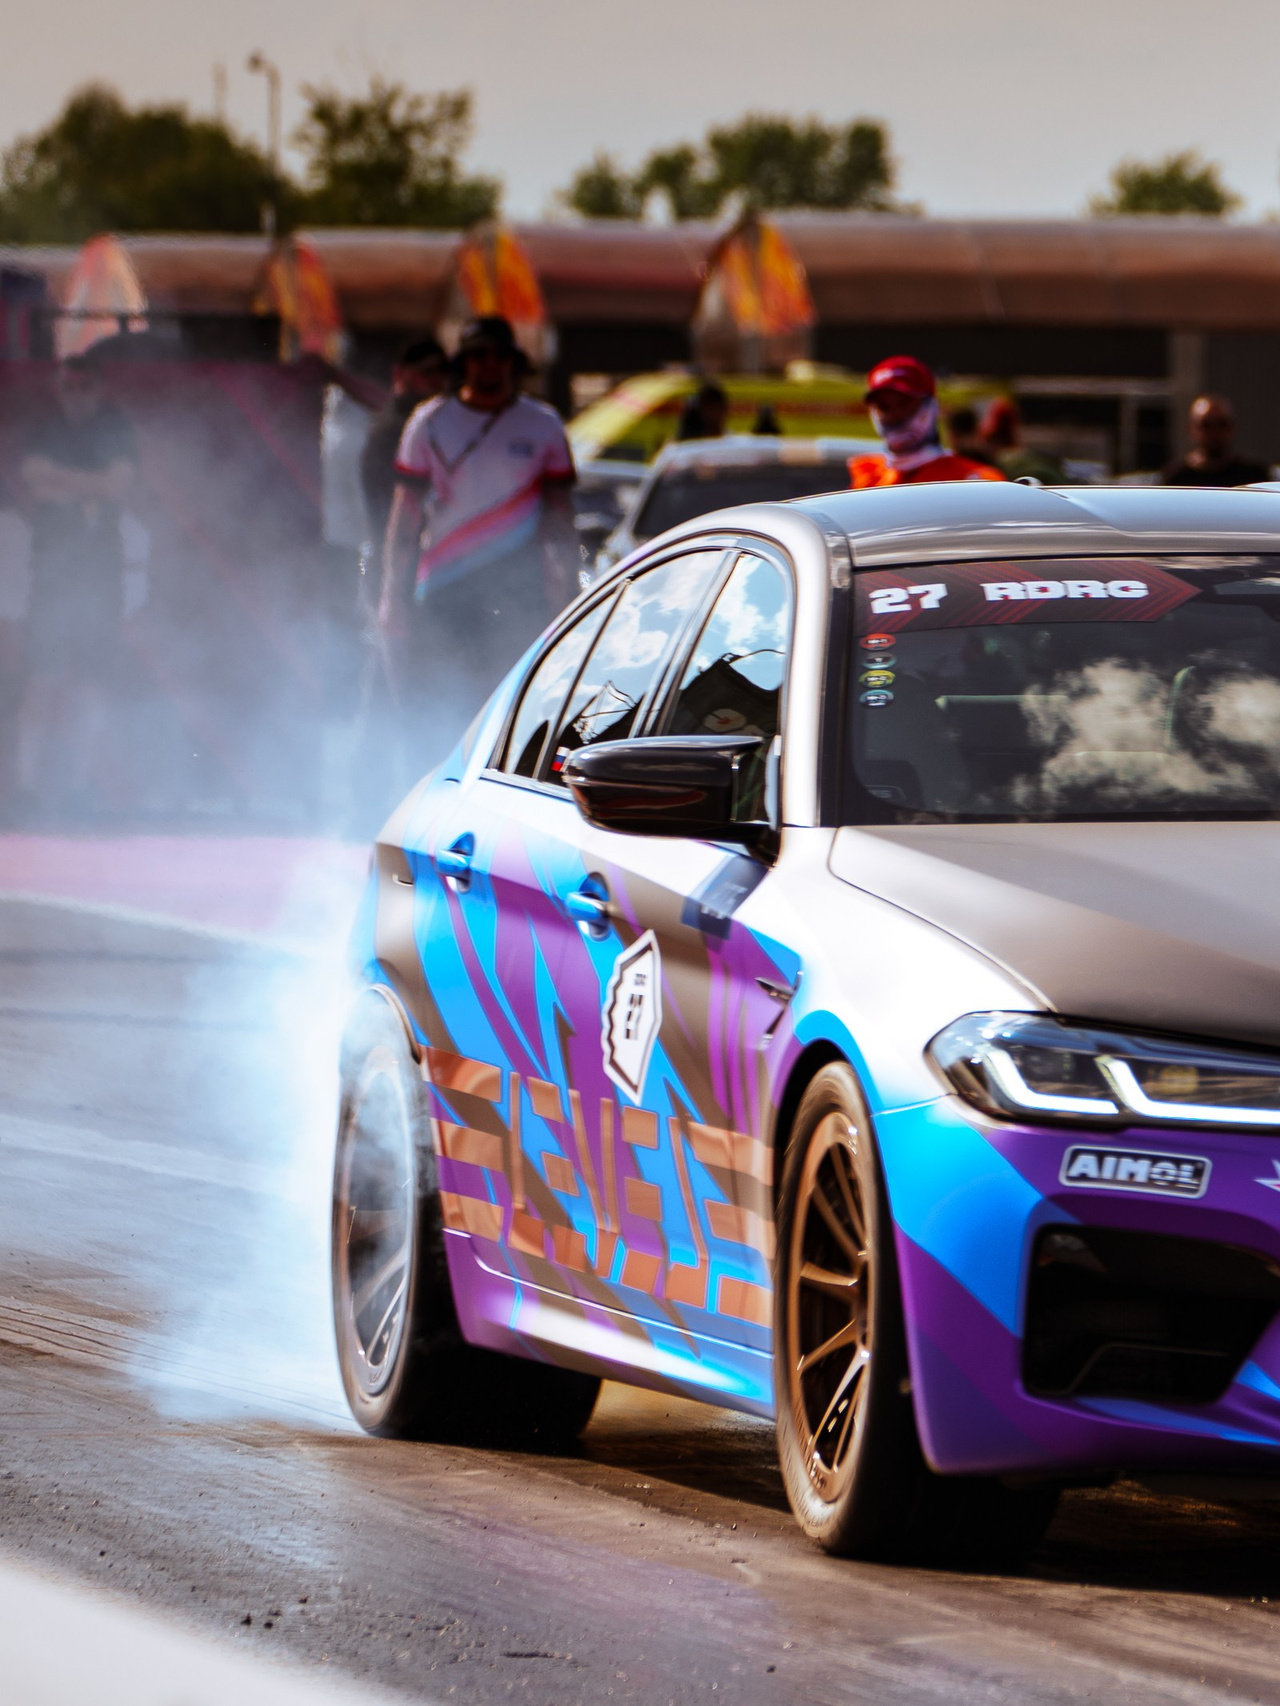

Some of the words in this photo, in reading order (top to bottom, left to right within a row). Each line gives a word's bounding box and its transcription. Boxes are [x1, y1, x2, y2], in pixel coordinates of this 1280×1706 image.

[868, 583, 948, 614] 27
[980, 580, 1149, 601] RDRC
[1066, 1153, 1201, 1190] AIMOL
